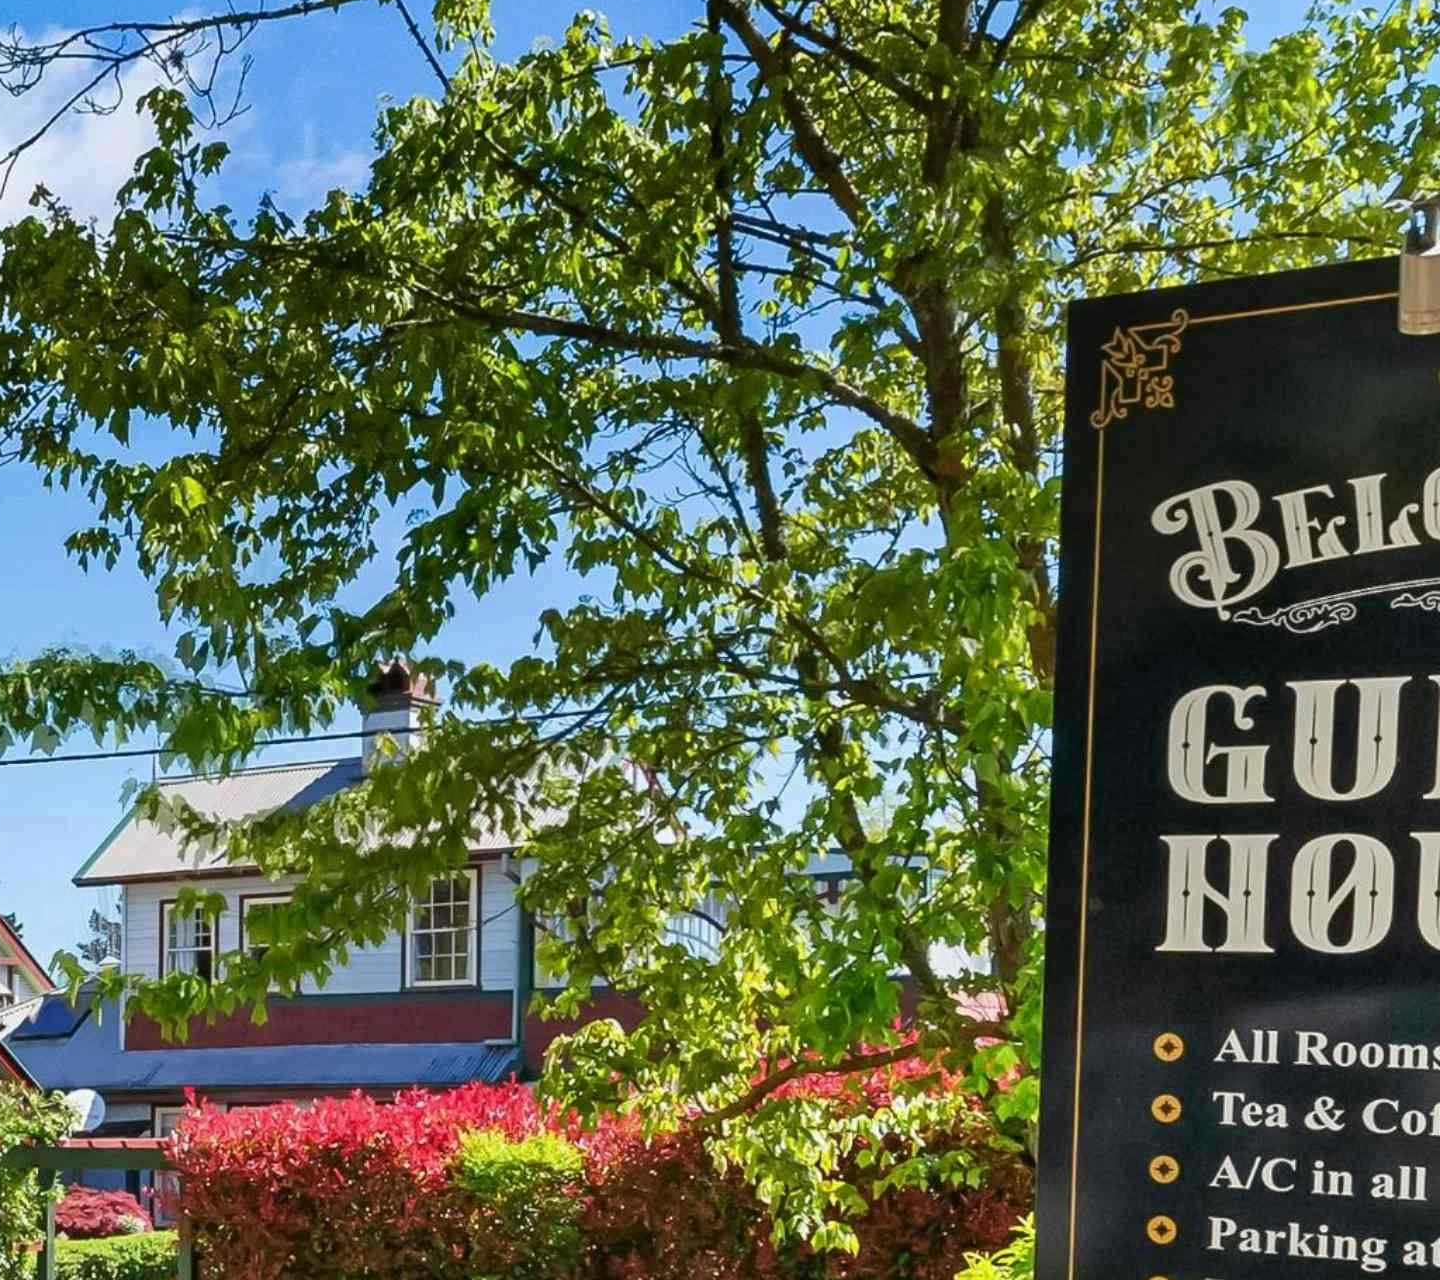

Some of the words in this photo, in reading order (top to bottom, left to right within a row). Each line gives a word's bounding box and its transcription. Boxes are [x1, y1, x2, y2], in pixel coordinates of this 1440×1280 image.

[1213, 1028, 1280, 1065] All
[1212, 1091, 1289, 1129] Tea
[1304, 1095, 1345, 1132] &
[1208, 1155, 1297, 1193] A/C
[1311, 1159, 1354, 1197] in
[1370, 1165, 1427, 1201] all
[1207, 1216, 1388, 1273] Parking
